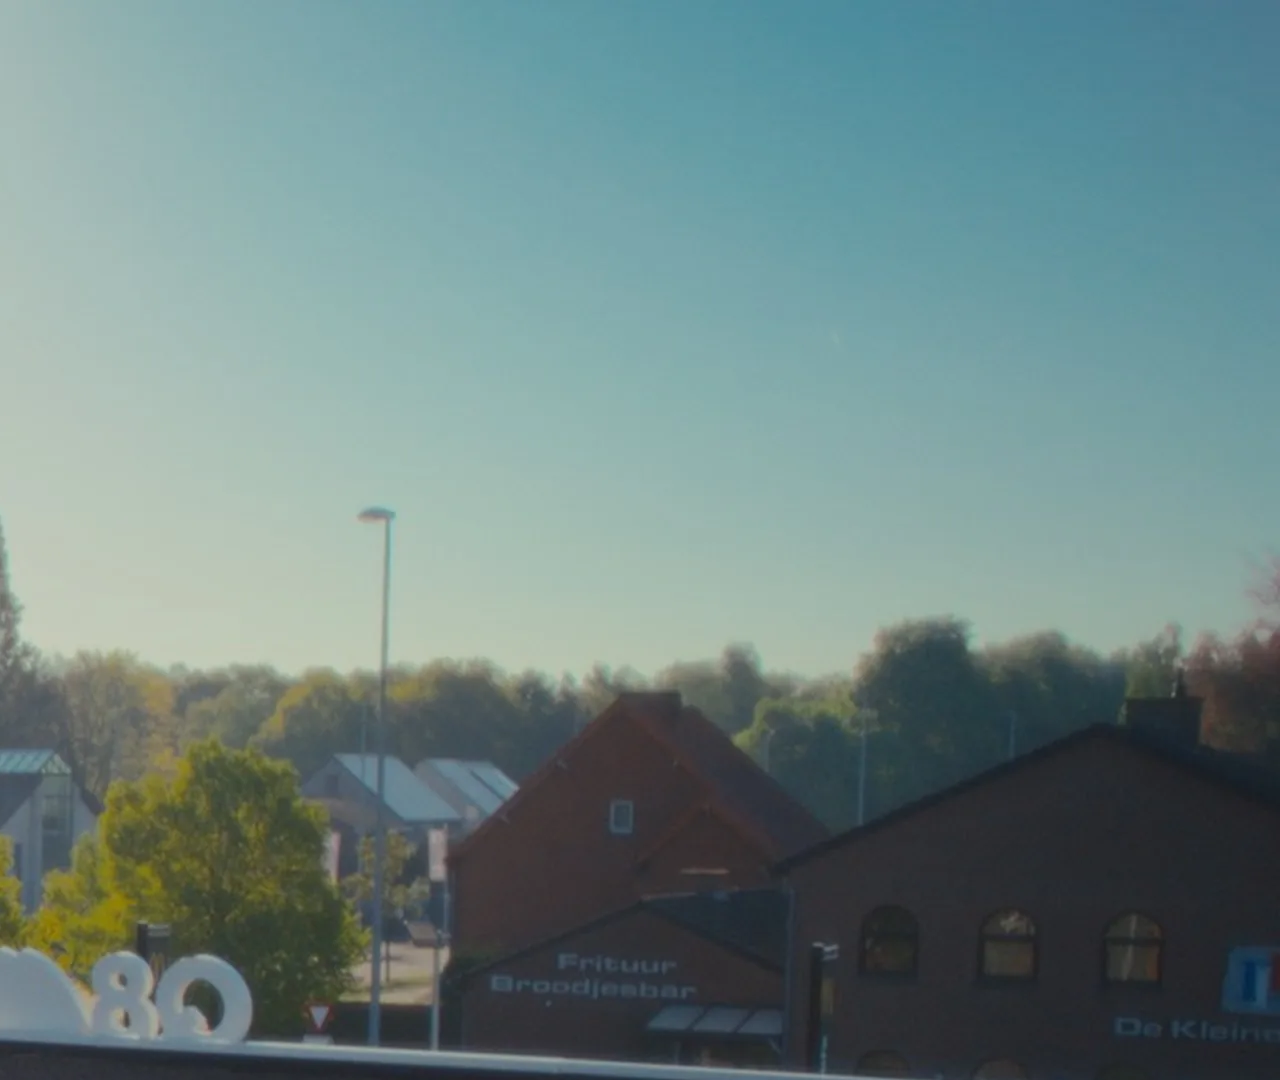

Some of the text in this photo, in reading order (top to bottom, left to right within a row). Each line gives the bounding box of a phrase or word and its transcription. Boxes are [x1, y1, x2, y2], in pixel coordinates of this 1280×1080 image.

[556, 953, 678, 976] Frituur
[490, 974, 697, 999] Broodjesbar
[1114, 1016, 1162, 1038] De
